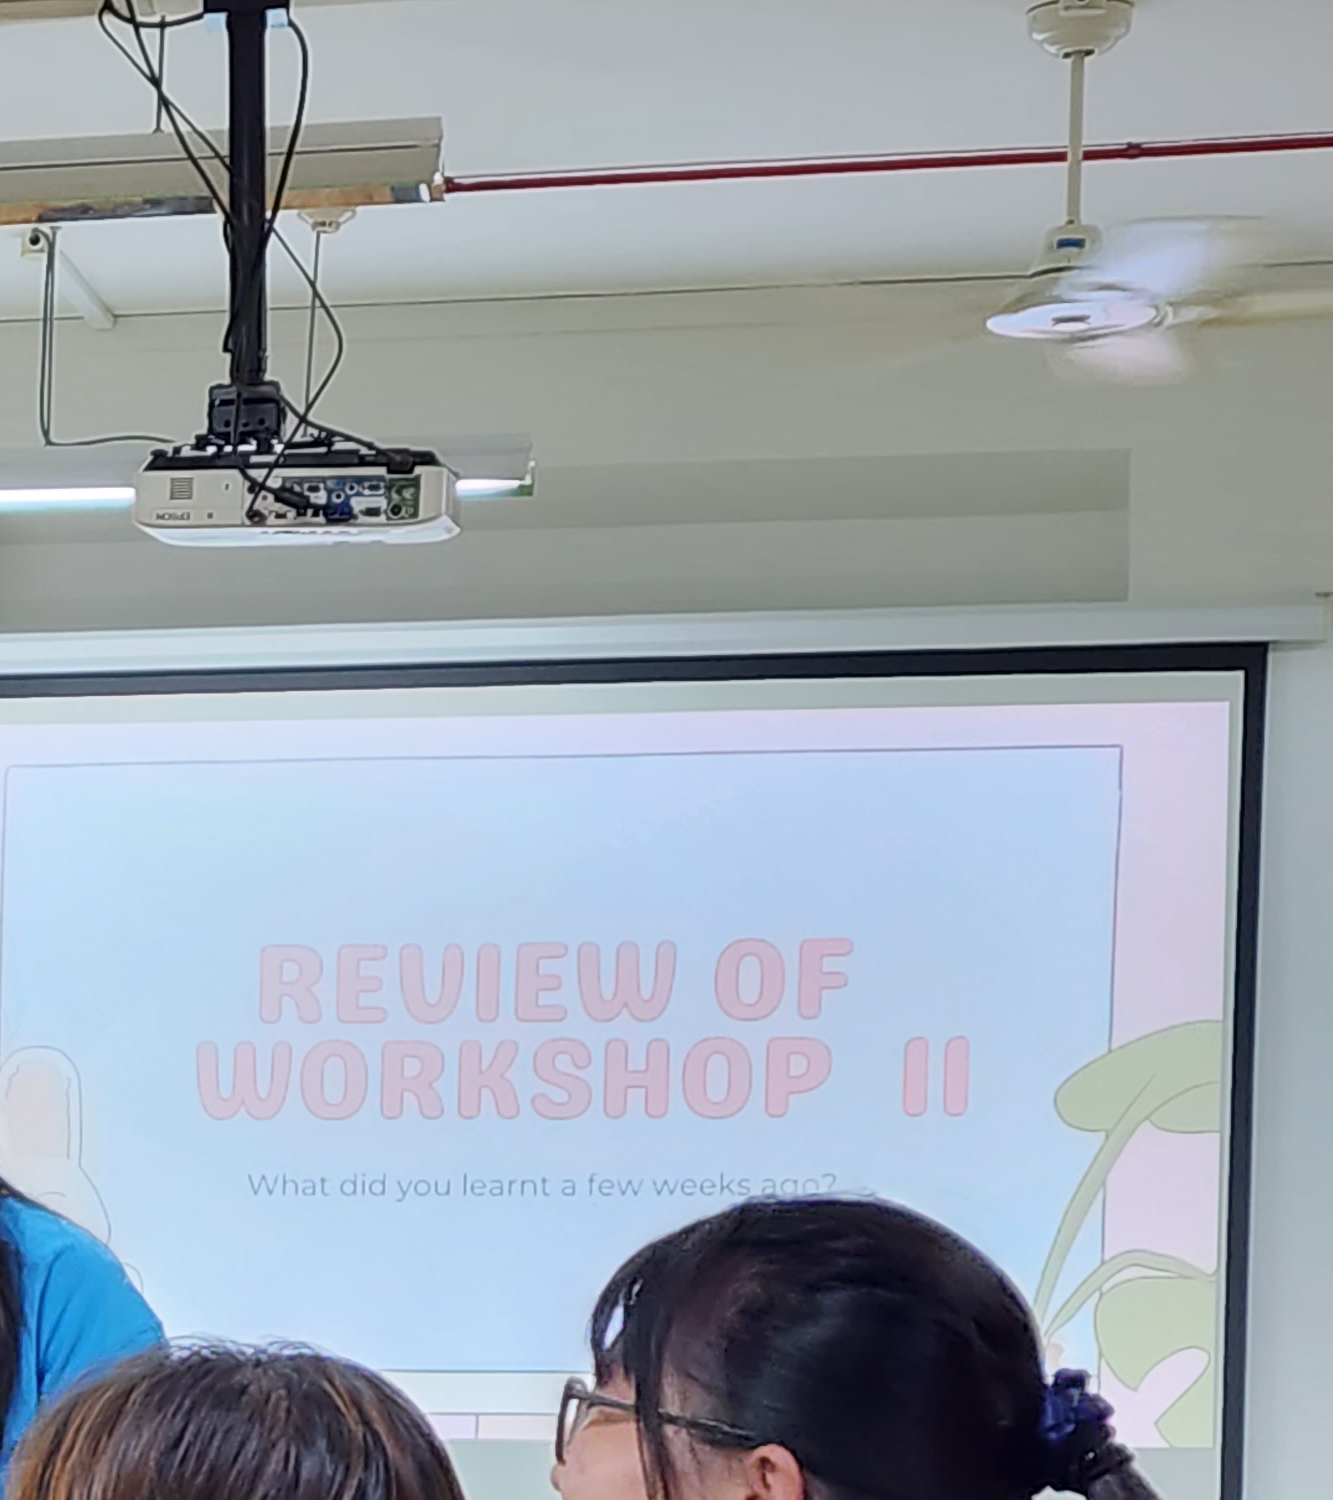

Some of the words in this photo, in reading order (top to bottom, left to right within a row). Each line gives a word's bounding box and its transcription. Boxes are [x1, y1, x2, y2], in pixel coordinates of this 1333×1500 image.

[258, 941, 677, 1024] REVIEW
[714, 937, 854, 1021] OF
[195, 1035, 833, 1121] WORKSHOP
[248, 1173, 330, 1197] What
[339, 1173, 387, 1197] did
[395, 1178, 454, 1202] you
[462, 1173, 551, 1197] learnt
[561, 1179, 576, 1197] a
[587, 1172, 644, 1196] few
[653, 1172, 750, 1196] weeks
